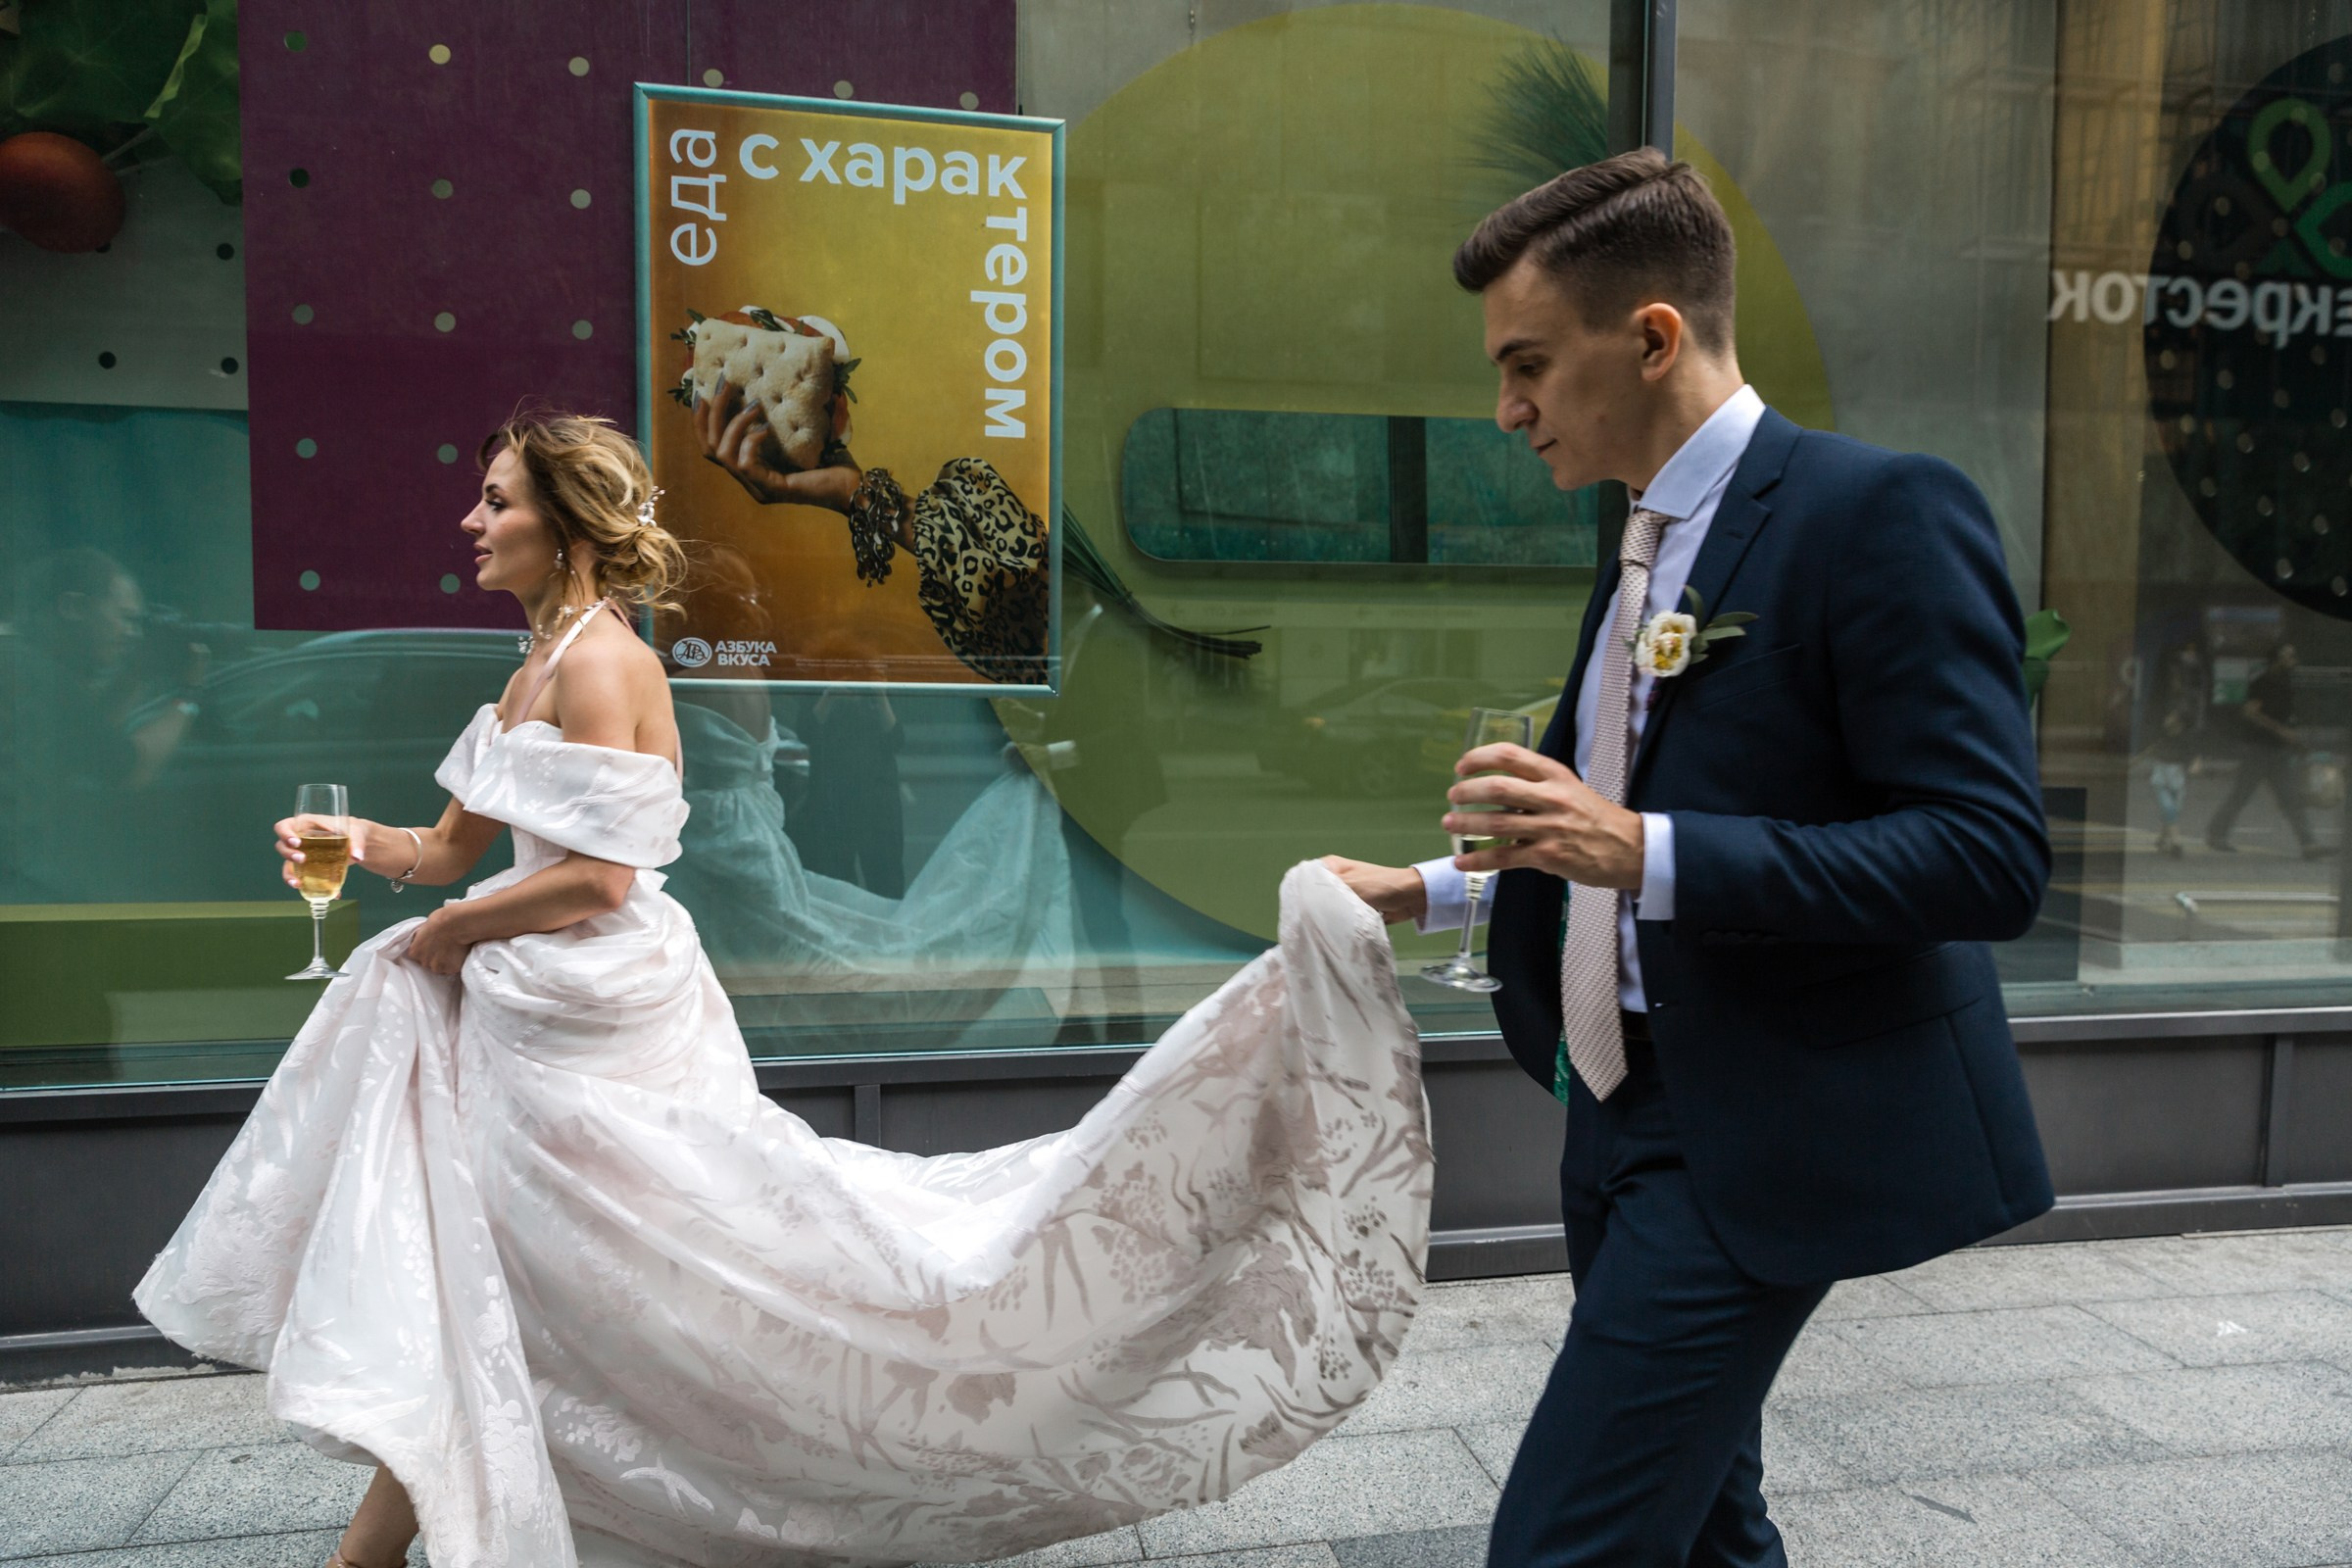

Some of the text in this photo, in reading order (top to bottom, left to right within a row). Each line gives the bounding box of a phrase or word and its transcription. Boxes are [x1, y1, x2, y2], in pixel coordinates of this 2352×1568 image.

[739, 133, 780, 179] с
[670, 128, 727, 266] еда
[714, 640, 777, 654] АЗБУКА
[717, 654, 771, 666] ВКУСА
